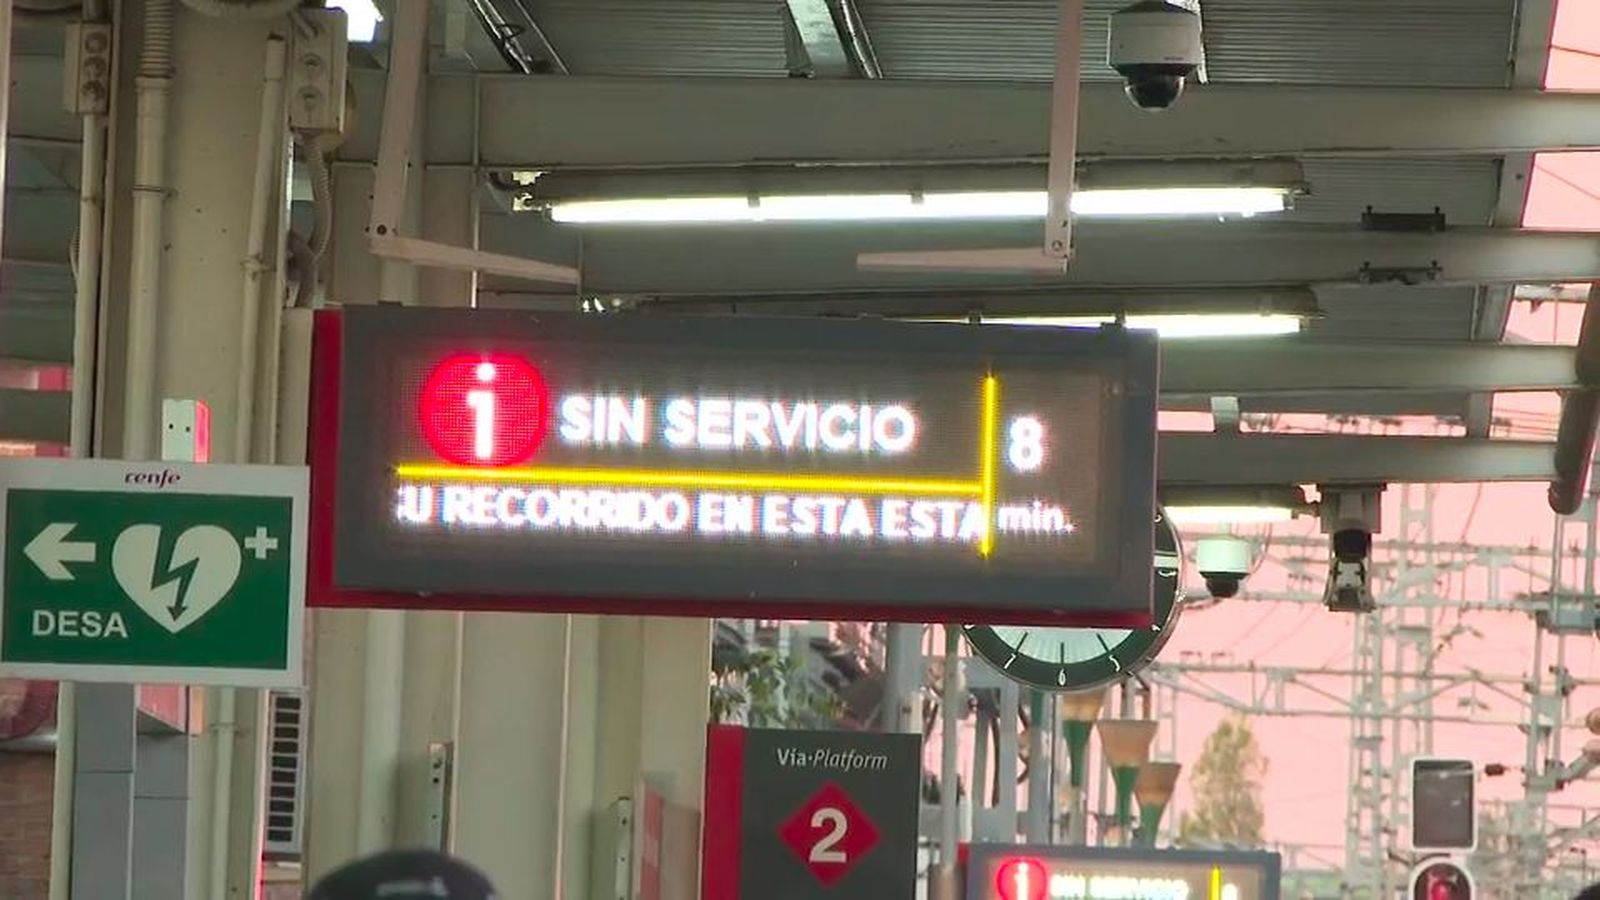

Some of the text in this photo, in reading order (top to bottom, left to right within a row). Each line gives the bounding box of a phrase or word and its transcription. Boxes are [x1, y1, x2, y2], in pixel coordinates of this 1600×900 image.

[559, 395, 917, 453] SIN SERVICIO
[1008, 415, 1047, 472] 8
[124, 469, 181, 488] renfe
[443, 486, 690, 532] RECORRIDO
[698, 492, 754, 533] EN
[763, 494, 874, 538] ESTA
[997, 499, 1074, 534] min.
[32, 609, 128, 639] DESA
[1057, 668, 1066, 687] 6
[808, 807, 848, 863] 2
